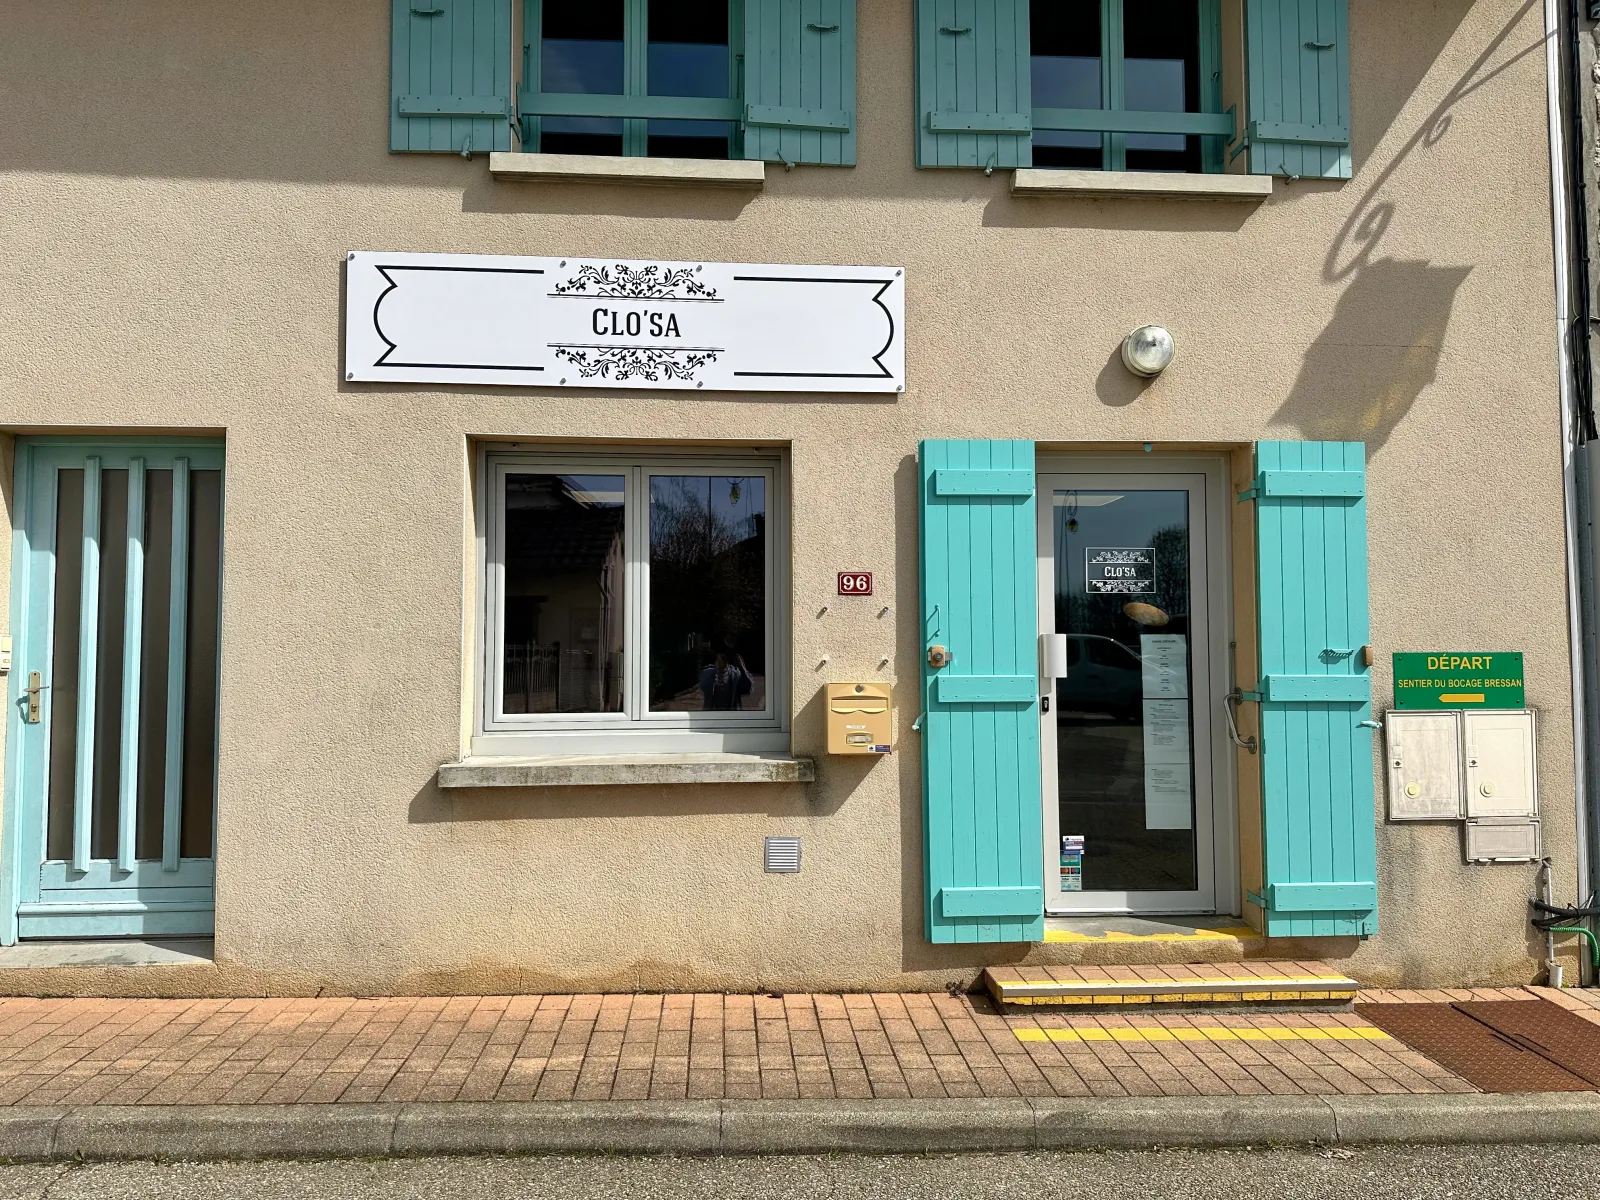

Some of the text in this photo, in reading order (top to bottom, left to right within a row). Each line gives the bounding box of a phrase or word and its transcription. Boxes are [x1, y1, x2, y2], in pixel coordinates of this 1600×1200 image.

[842, 575, 868, 592] 96
[1427, 653, 1493, 670] DÉPART
[1398, 678, 1522, 688] SENTIER DU BOCAGE BRESSAN
